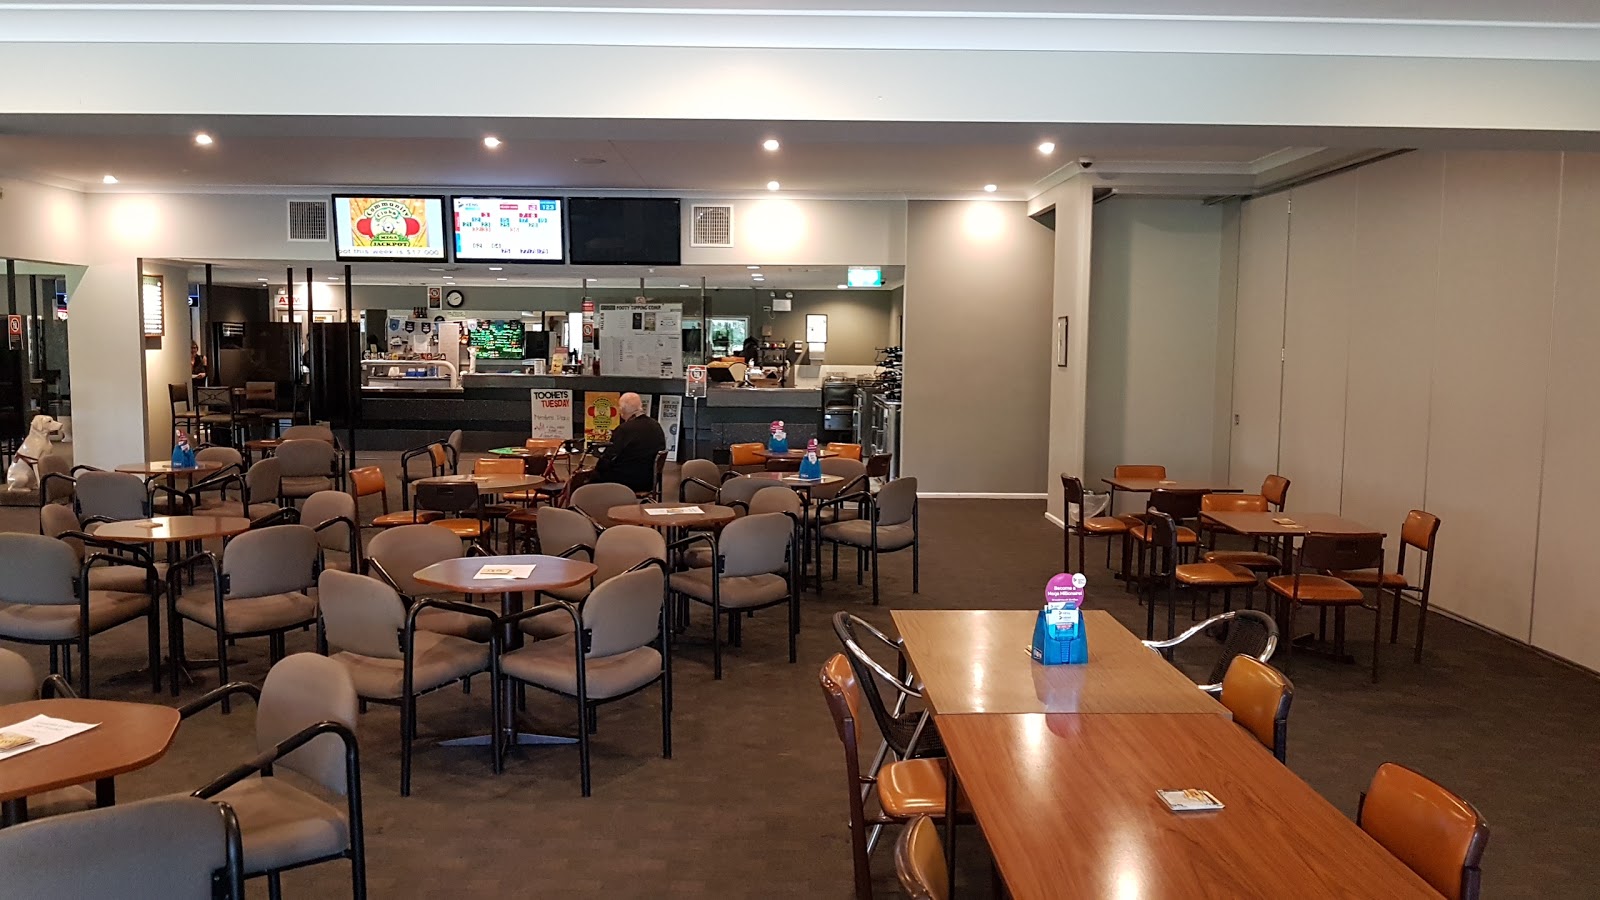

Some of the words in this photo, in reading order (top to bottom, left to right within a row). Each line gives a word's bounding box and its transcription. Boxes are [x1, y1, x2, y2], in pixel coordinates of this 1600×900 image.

[367, 202, 409, 217] Community
[533, 391, 569, 400] TOOHEYS
[541, 399, 570, 408] TUESDAY
